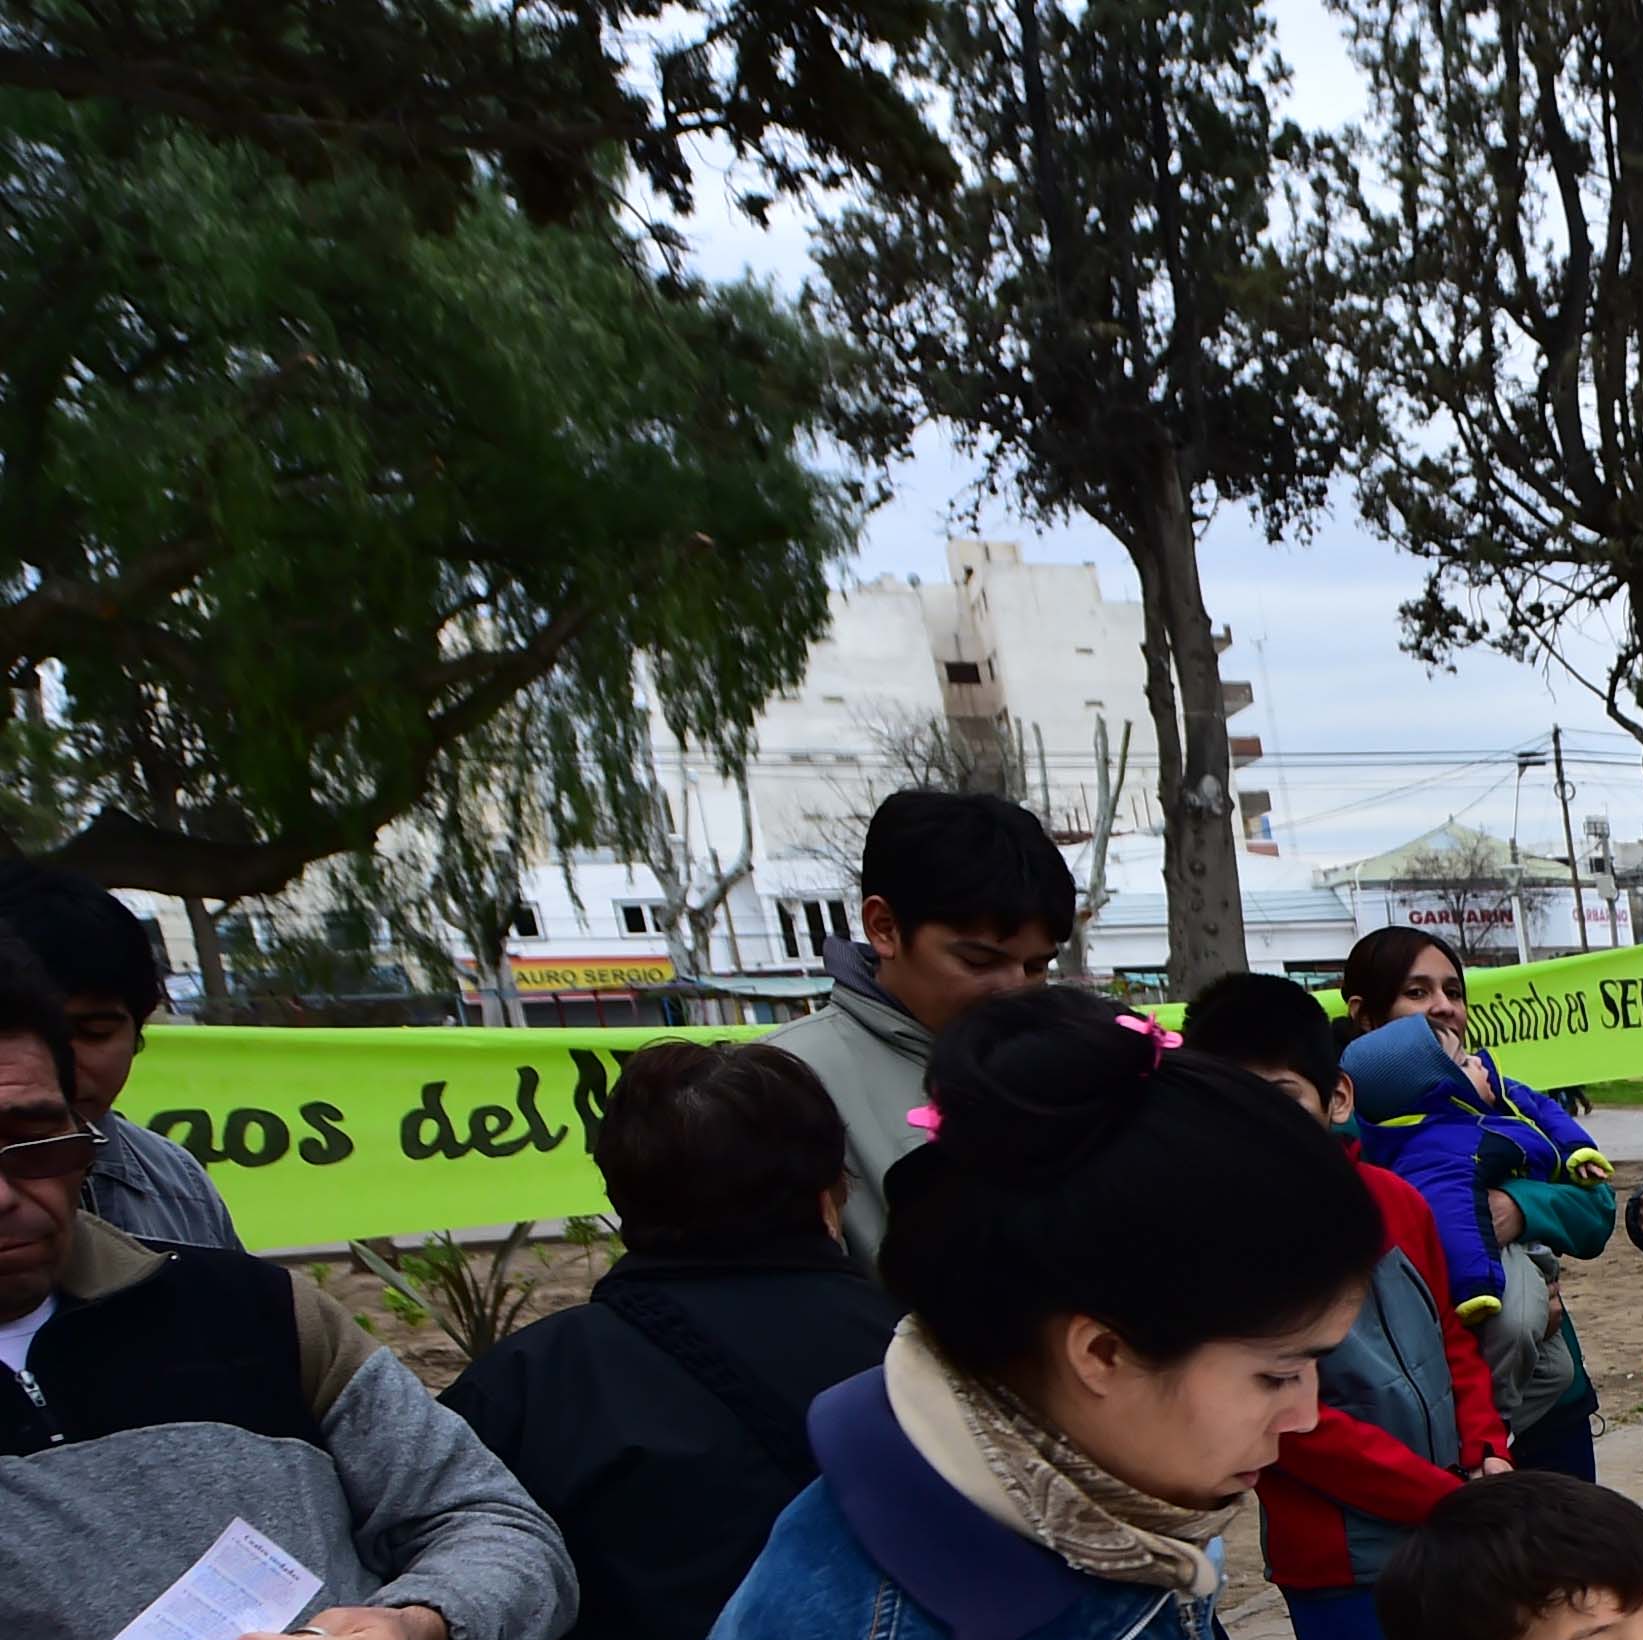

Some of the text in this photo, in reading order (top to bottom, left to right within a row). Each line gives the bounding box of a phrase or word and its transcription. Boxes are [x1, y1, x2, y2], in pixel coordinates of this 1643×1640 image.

[1409, 909, 1514, 924] GARARIN
[514, 966, 664, 986] AURO SERGIO
[1464, 981, 1562, 1053] unciarlo
[1565, 991, 1589, 1035] es
[401, 1066, 569, 1160] del
